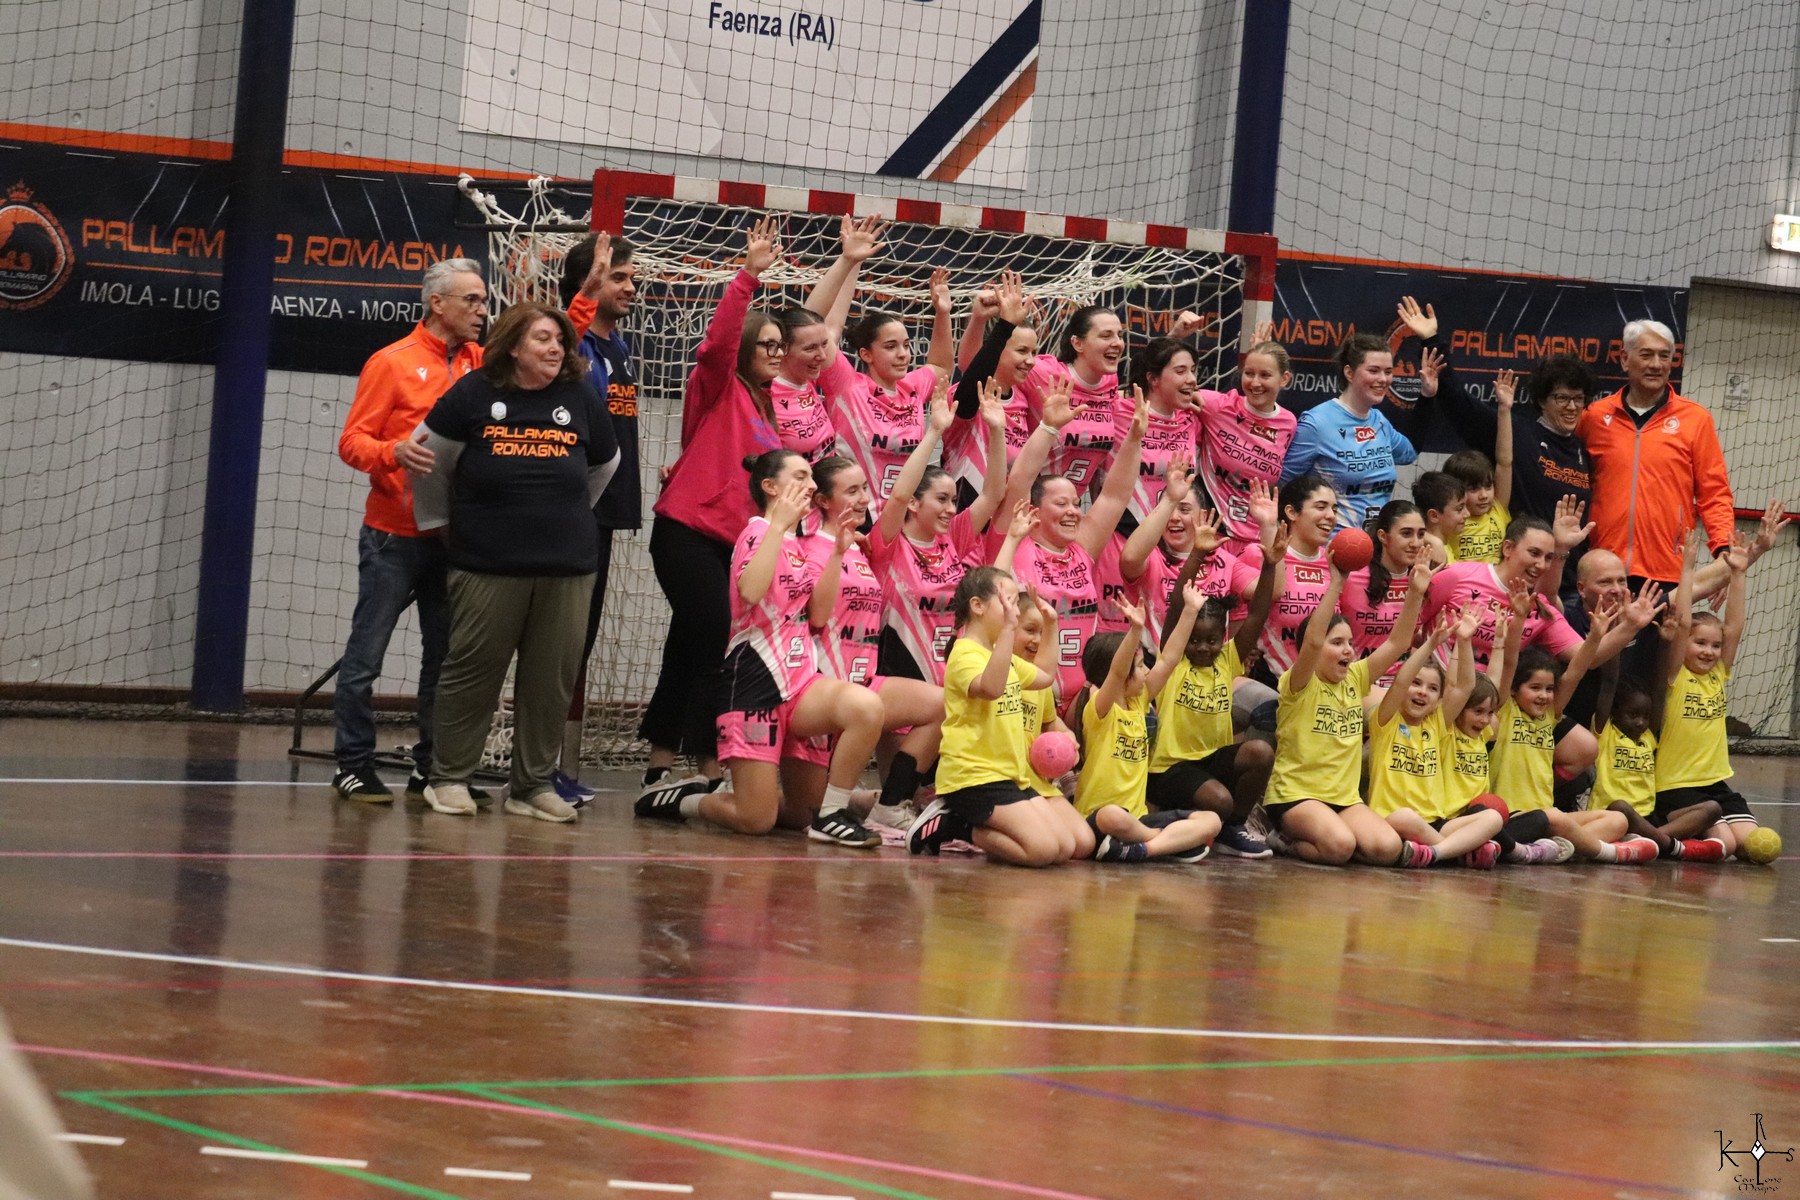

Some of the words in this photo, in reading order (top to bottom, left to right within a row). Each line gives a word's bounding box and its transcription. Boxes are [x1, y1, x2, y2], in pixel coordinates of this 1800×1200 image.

[708, 2, 782, 37] Faenza
[789, 12, 835, 51] (RA)
[80, 280, 154, 307] IMOLA
[173, 286, 221, 311] LUG
[270, 296, 344, 319] AENZA
[361, 301, 424, 324] MORD
[1270, 319, 1356, 347] MAGNA
[1450, 329, 1600, 363] PALLAMANO
[1284, 373, 1338, 394] ORDAN
[482, 425, 578, 446] PALLAMANO
[491, 442, 569, 457] ROMAGNA
[1298, 570, 1321, 581] CLAI
[842, 586, 882, 598] PALLAMA
[1279, 604, 1317, 615] ROMA
